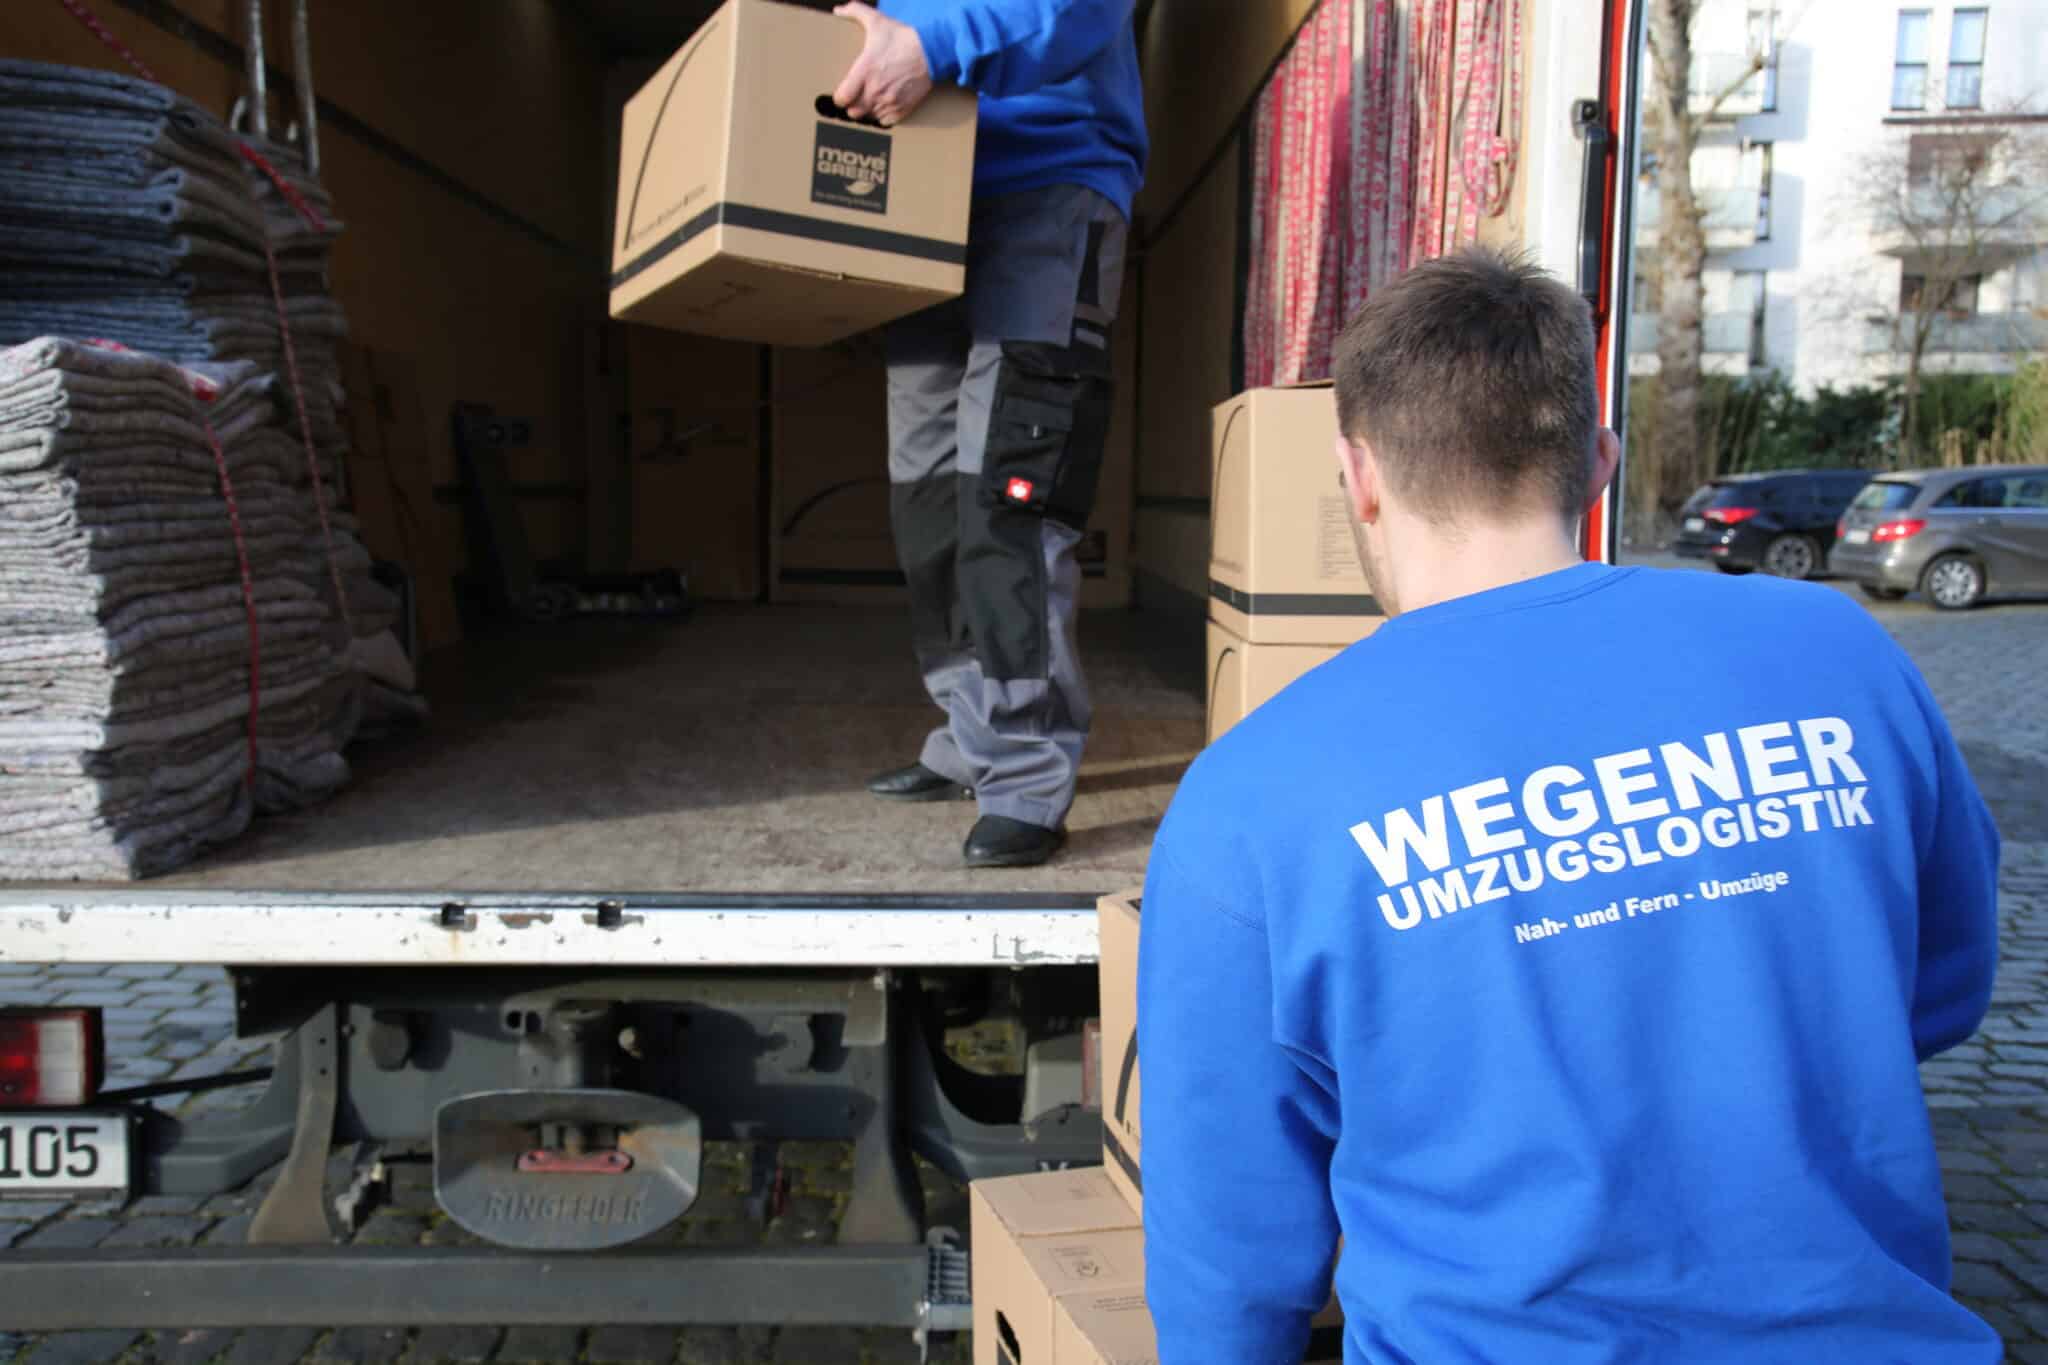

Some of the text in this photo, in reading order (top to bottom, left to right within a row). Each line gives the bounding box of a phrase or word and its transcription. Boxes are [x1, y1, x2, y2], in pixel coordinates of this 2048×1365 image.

[816, 160, 886, 185] GREEN
[817, 146, 887, 171] move
[1348, 716, 1868, 889] WEGENER
[1377, 786, 1874, 931] UMZUGSLOGISTIK
[1514, 917, 1568, 944] Nah-
[1573, 902, 1621, 929] und
[1624, 893, 1680, 918] Fern
[1698, 871, 1789, 901] Umzüge
[0, 1125, 98, 1178] 105
